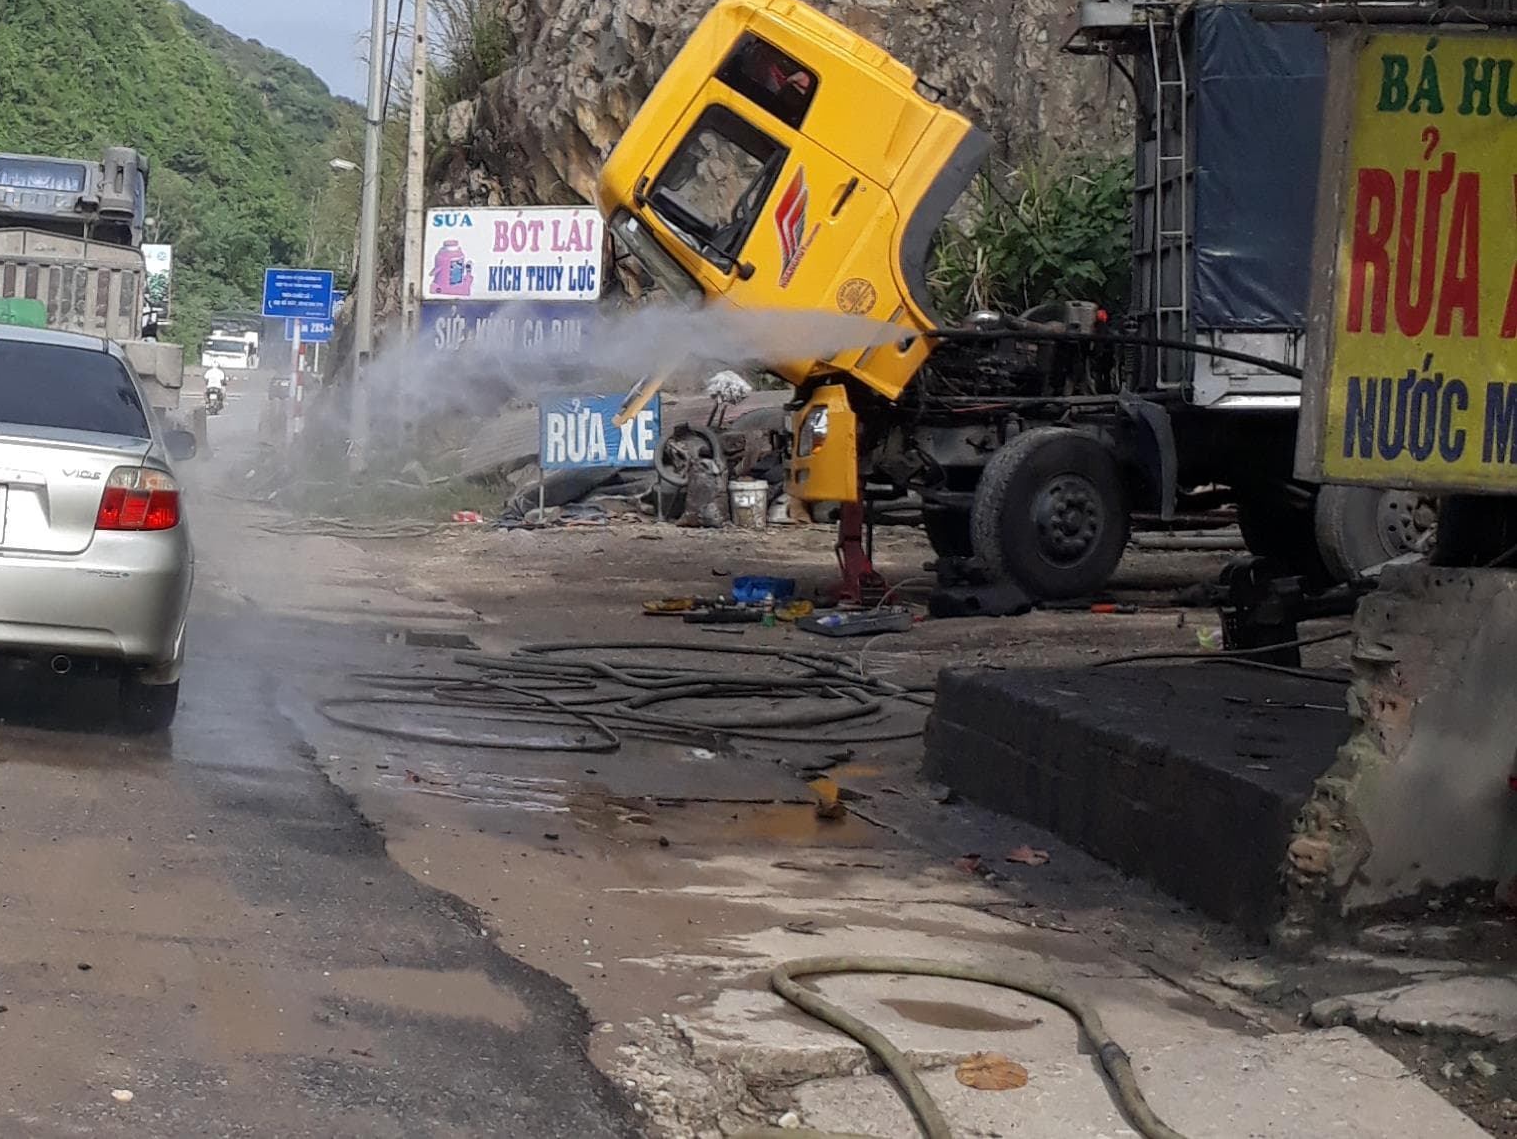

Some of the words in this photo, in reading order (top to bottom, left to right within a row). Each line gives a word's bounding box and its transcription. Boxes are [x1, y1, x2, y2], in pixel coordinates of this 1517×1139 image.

[1377, 37, 1443, 116] BÁ
[493, 211, 544, 252] BÓT
[550, 211, 595, 252] LÁI
[1346, 125, 1481, 339] RỬA
[488, 259, 521, 291] KÍCH
[568, 259, 595, 298] LỰC
[546, 398, 607, 462] RỬA
[618, 410, 655, 461] XE
[1343, 353, 1469, 461] NƯỚC
